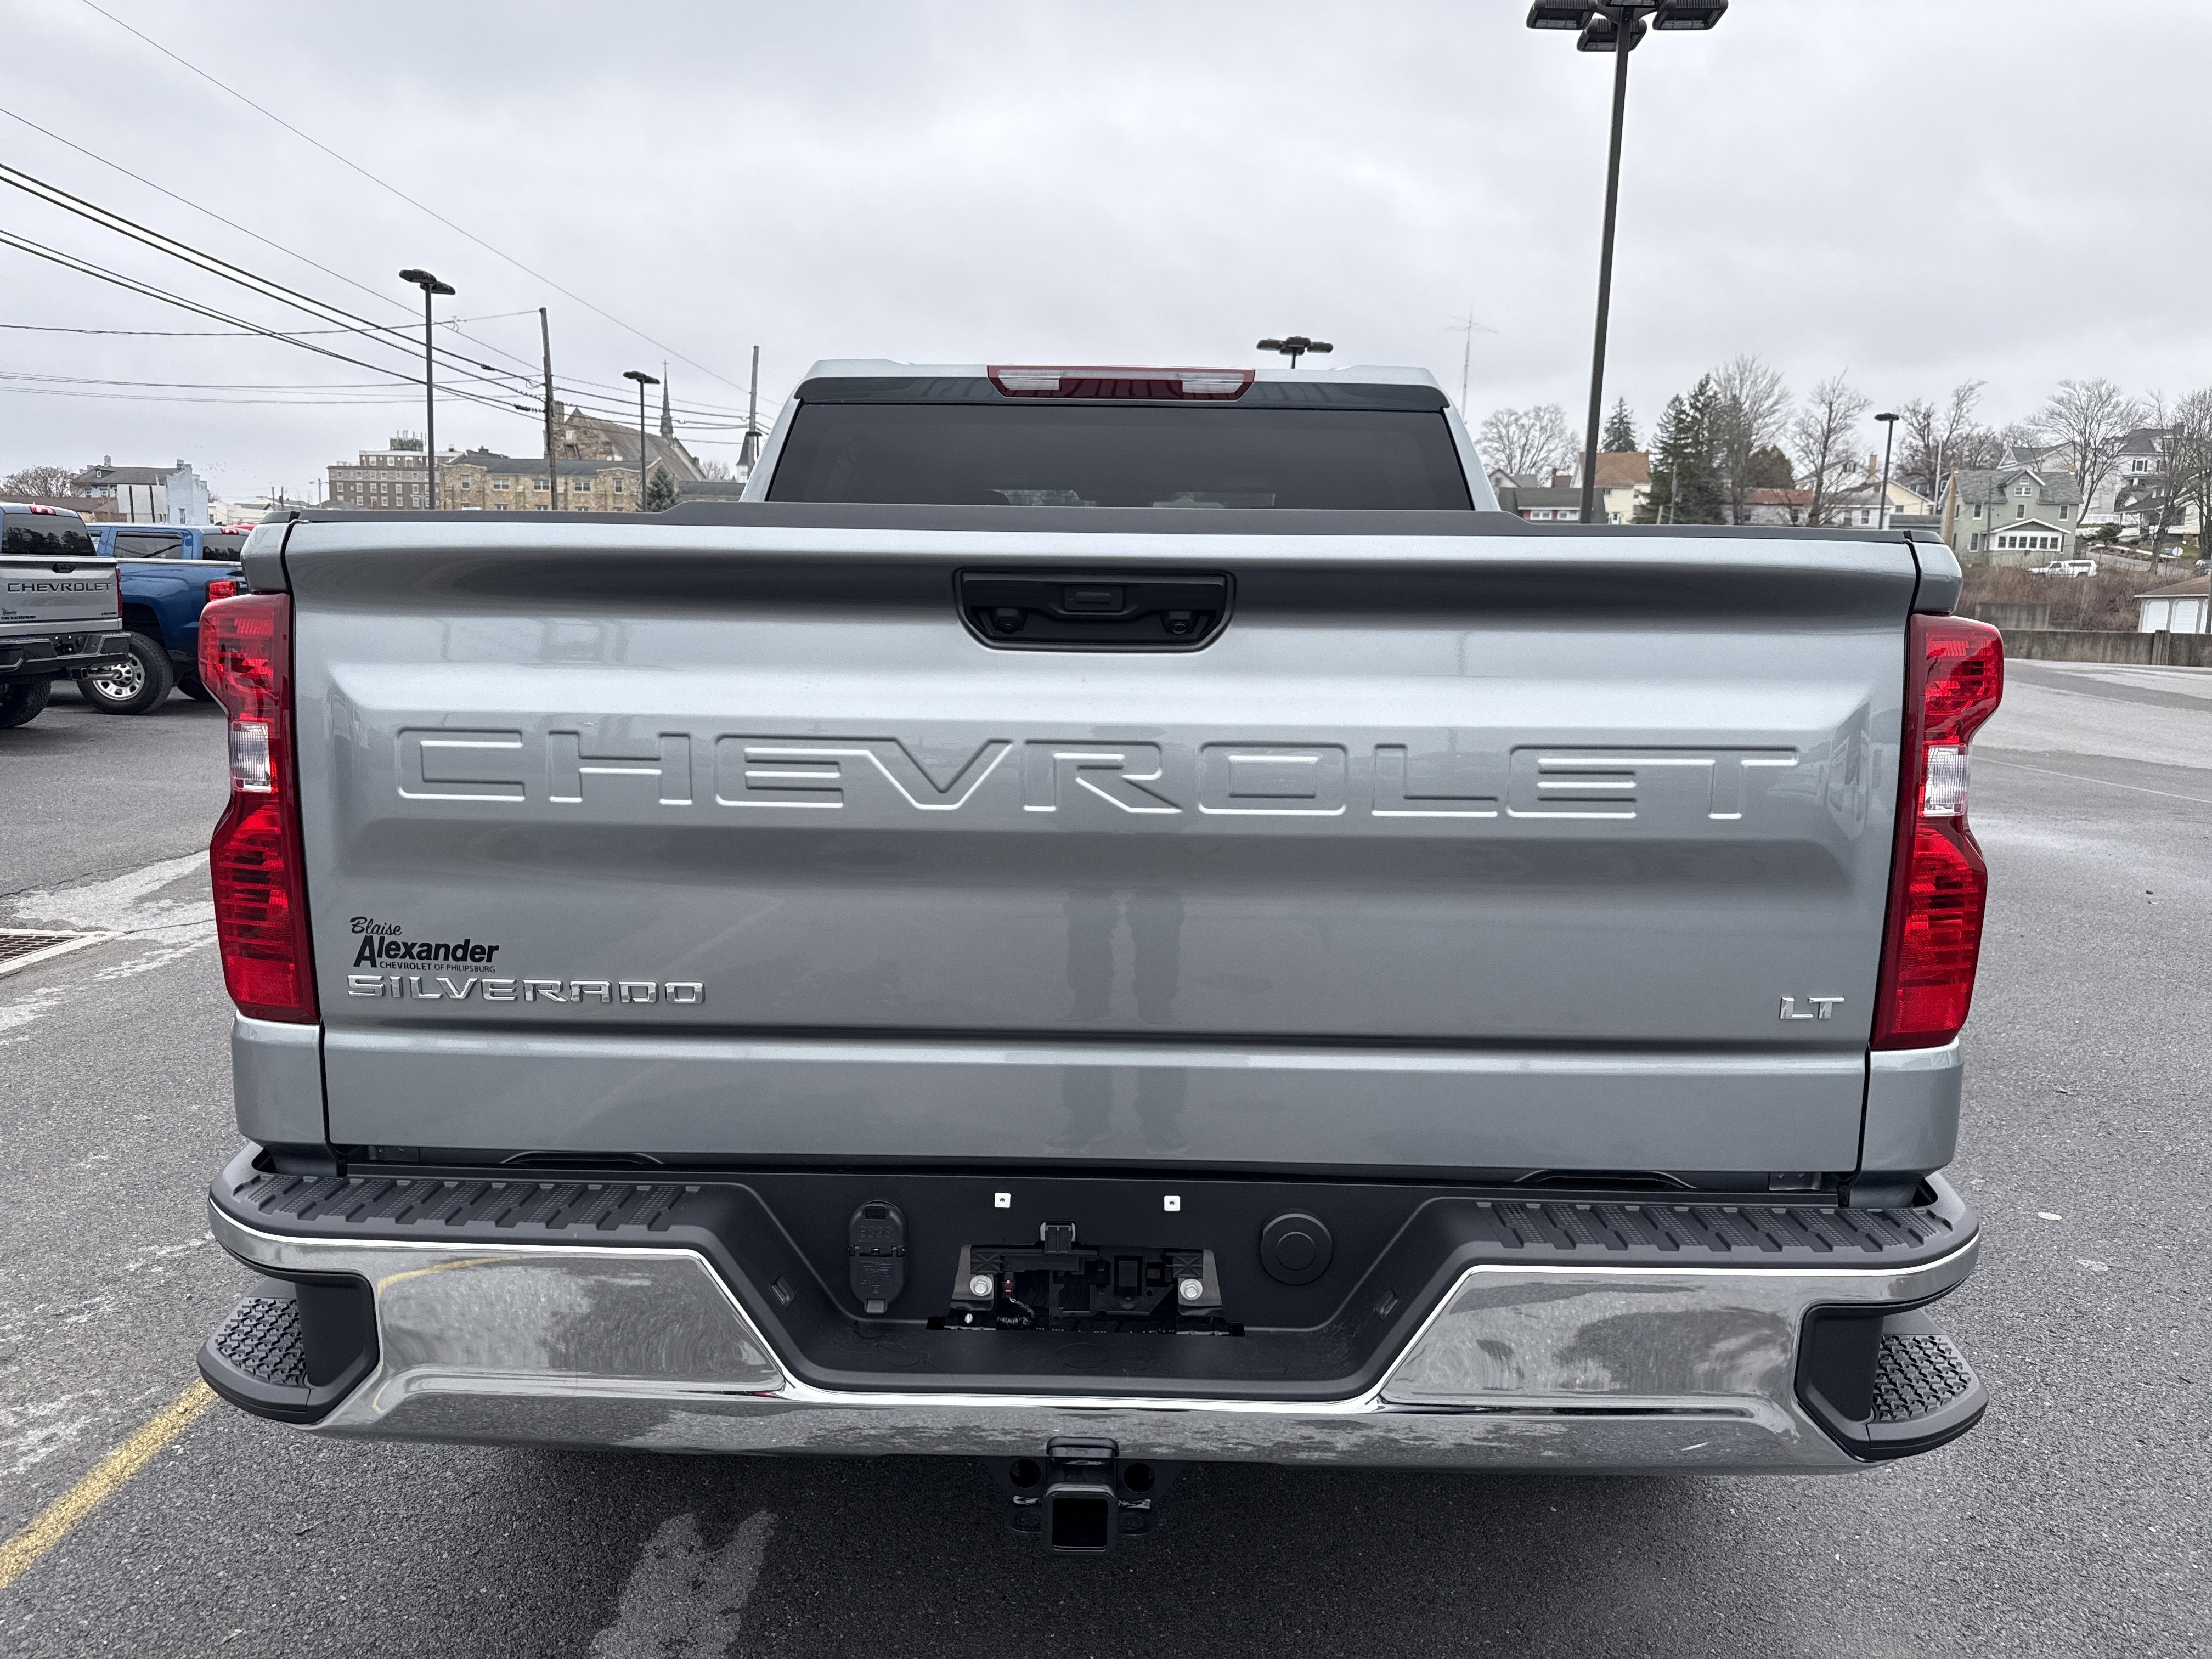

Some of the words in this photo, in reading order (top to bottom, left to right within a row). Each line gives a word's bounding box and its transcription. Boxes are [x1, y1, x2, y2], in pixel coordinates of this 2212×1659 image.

[7, 583, 111, 592] CHEVROLET
[395, 727, 1801, 821] CHEVROLET
[349, 916, 403, 936] Blaise
[353, 935, 500, 968] Alexander
[379, 961, 432, 970] CHEVROLET
[446, 964, 495, 973] PHILIPSBURG
[347, 974, 706, 1004] SILVERADO
[1779, 997, 1845, 1019] LT
